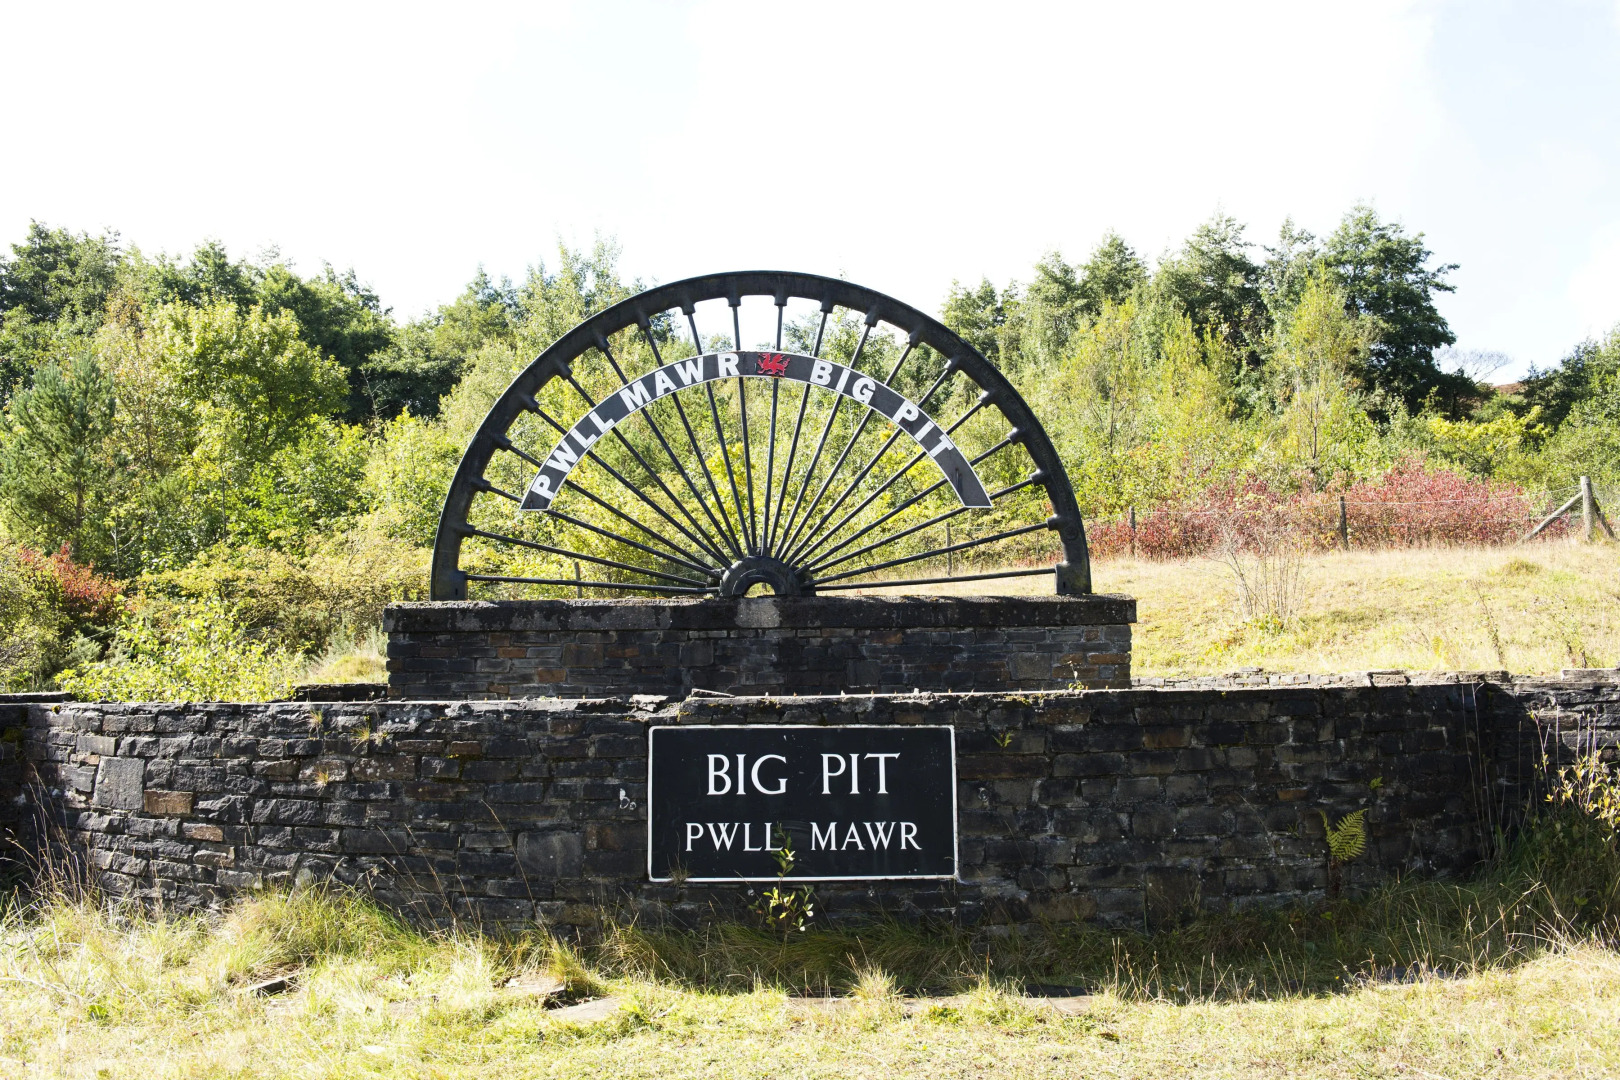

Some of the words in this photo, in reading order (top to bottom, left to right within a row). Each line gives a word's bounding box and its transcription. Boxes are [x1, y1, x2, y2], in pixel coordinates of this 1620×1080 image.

[531, 411, 615, 500] PWLL
[619, 353, 740, 413] MAWR
[810, 359, 876, 404] BIG
[892, 400, 954, 457] PIT
[707, 754, 788, 795] BIG
[821, 752, 900, 795] PIT
[685, 822, 783, 851] PWLL
[810, 821, 922, 850] MAWR
